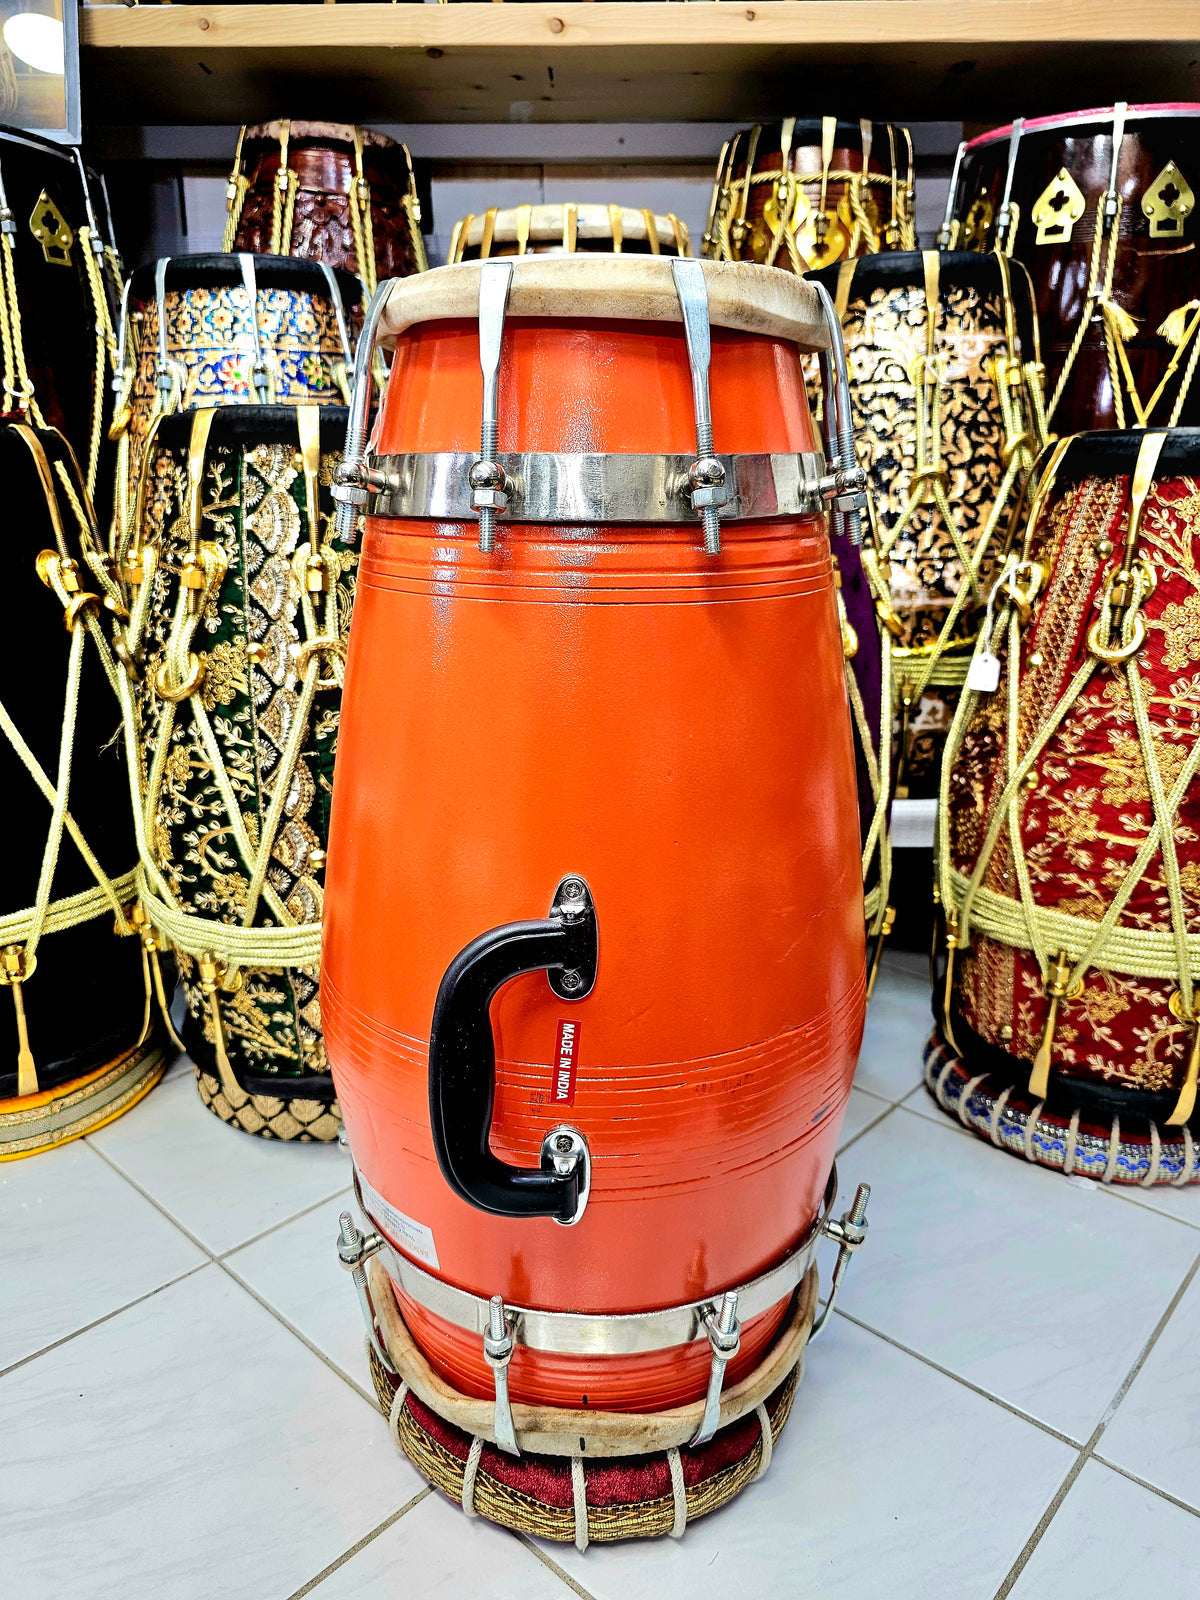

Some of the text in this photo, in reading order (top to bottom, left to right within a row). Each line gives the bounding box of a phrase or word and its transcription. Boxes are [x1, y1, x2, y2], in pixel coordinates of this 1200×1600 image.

[556, 1023, 575, 1099] MADE IN INDIA
